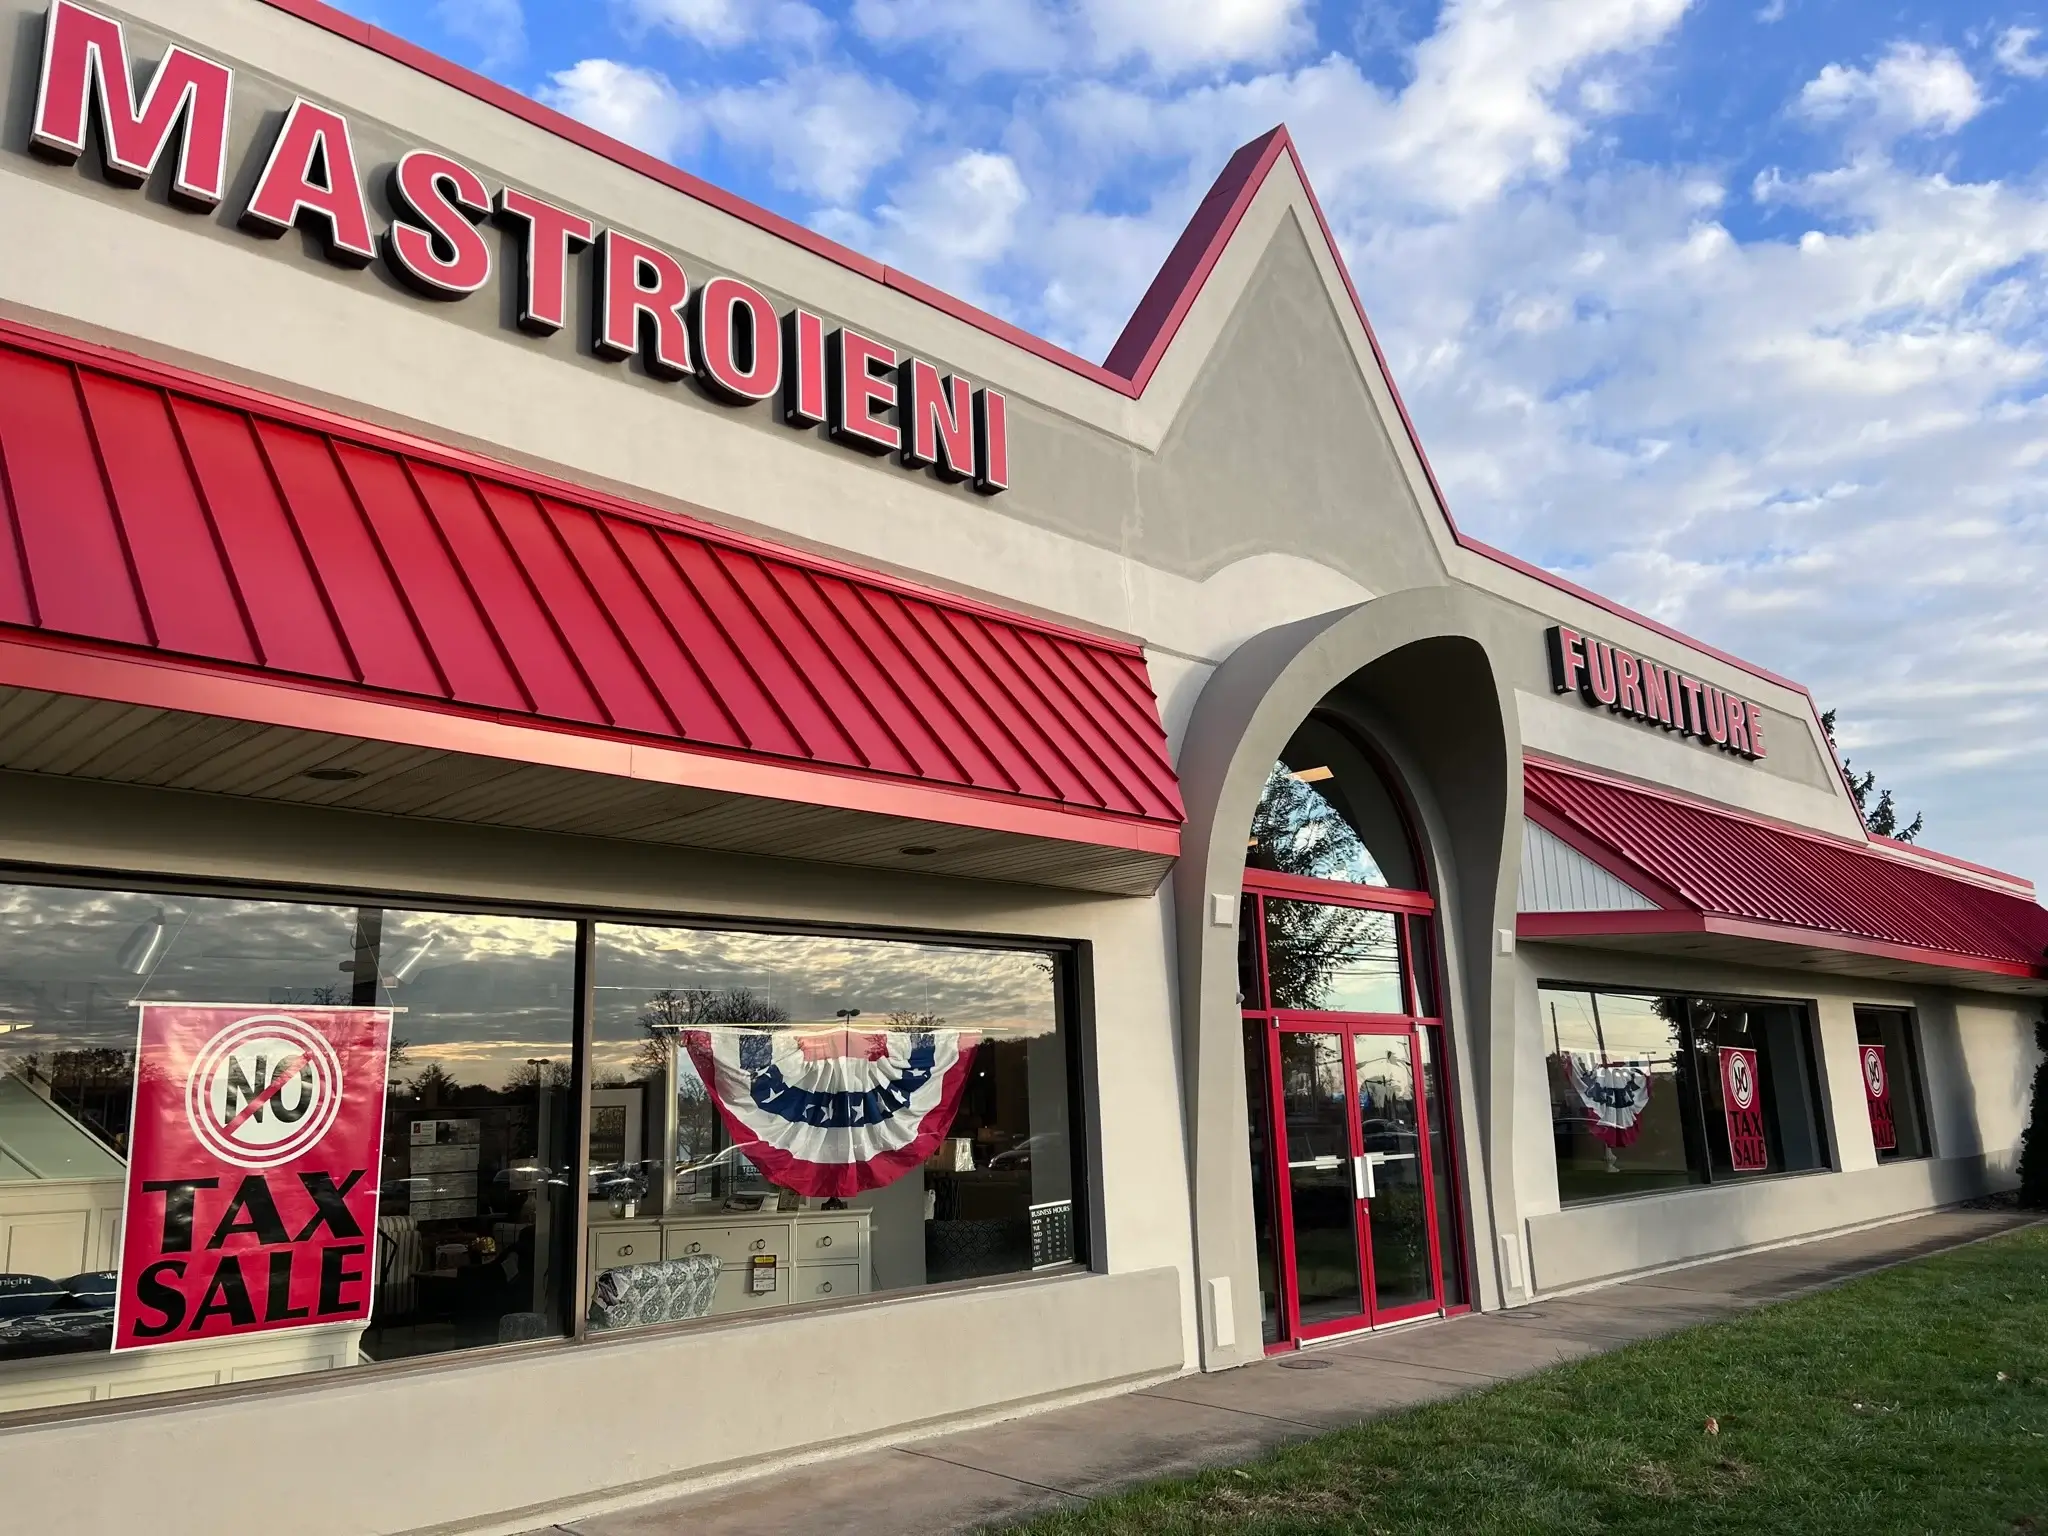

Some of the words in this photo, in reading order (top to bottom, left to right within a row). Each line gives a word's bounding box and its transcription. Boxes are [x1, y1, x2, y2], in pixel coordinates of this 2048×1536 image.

[30, 0, 1008, 492] MASTROIENI
[1556, 625, 1767, 760] FURNITURE
[224, 1053, 314, 1125] NO
[1733, 1066, 1748, 1093] NO
[1729, 1110, 1763, 1138] TAX
[1868, 1099, 1892, 1121] TAX
[1733, 1139, 1766, 1166] SALE
[141, 1168, 368, 1255] TAX
[1031, 1208, 1052, 1218] BUSINESS
[132, 1243, 366, 1339] SALE
